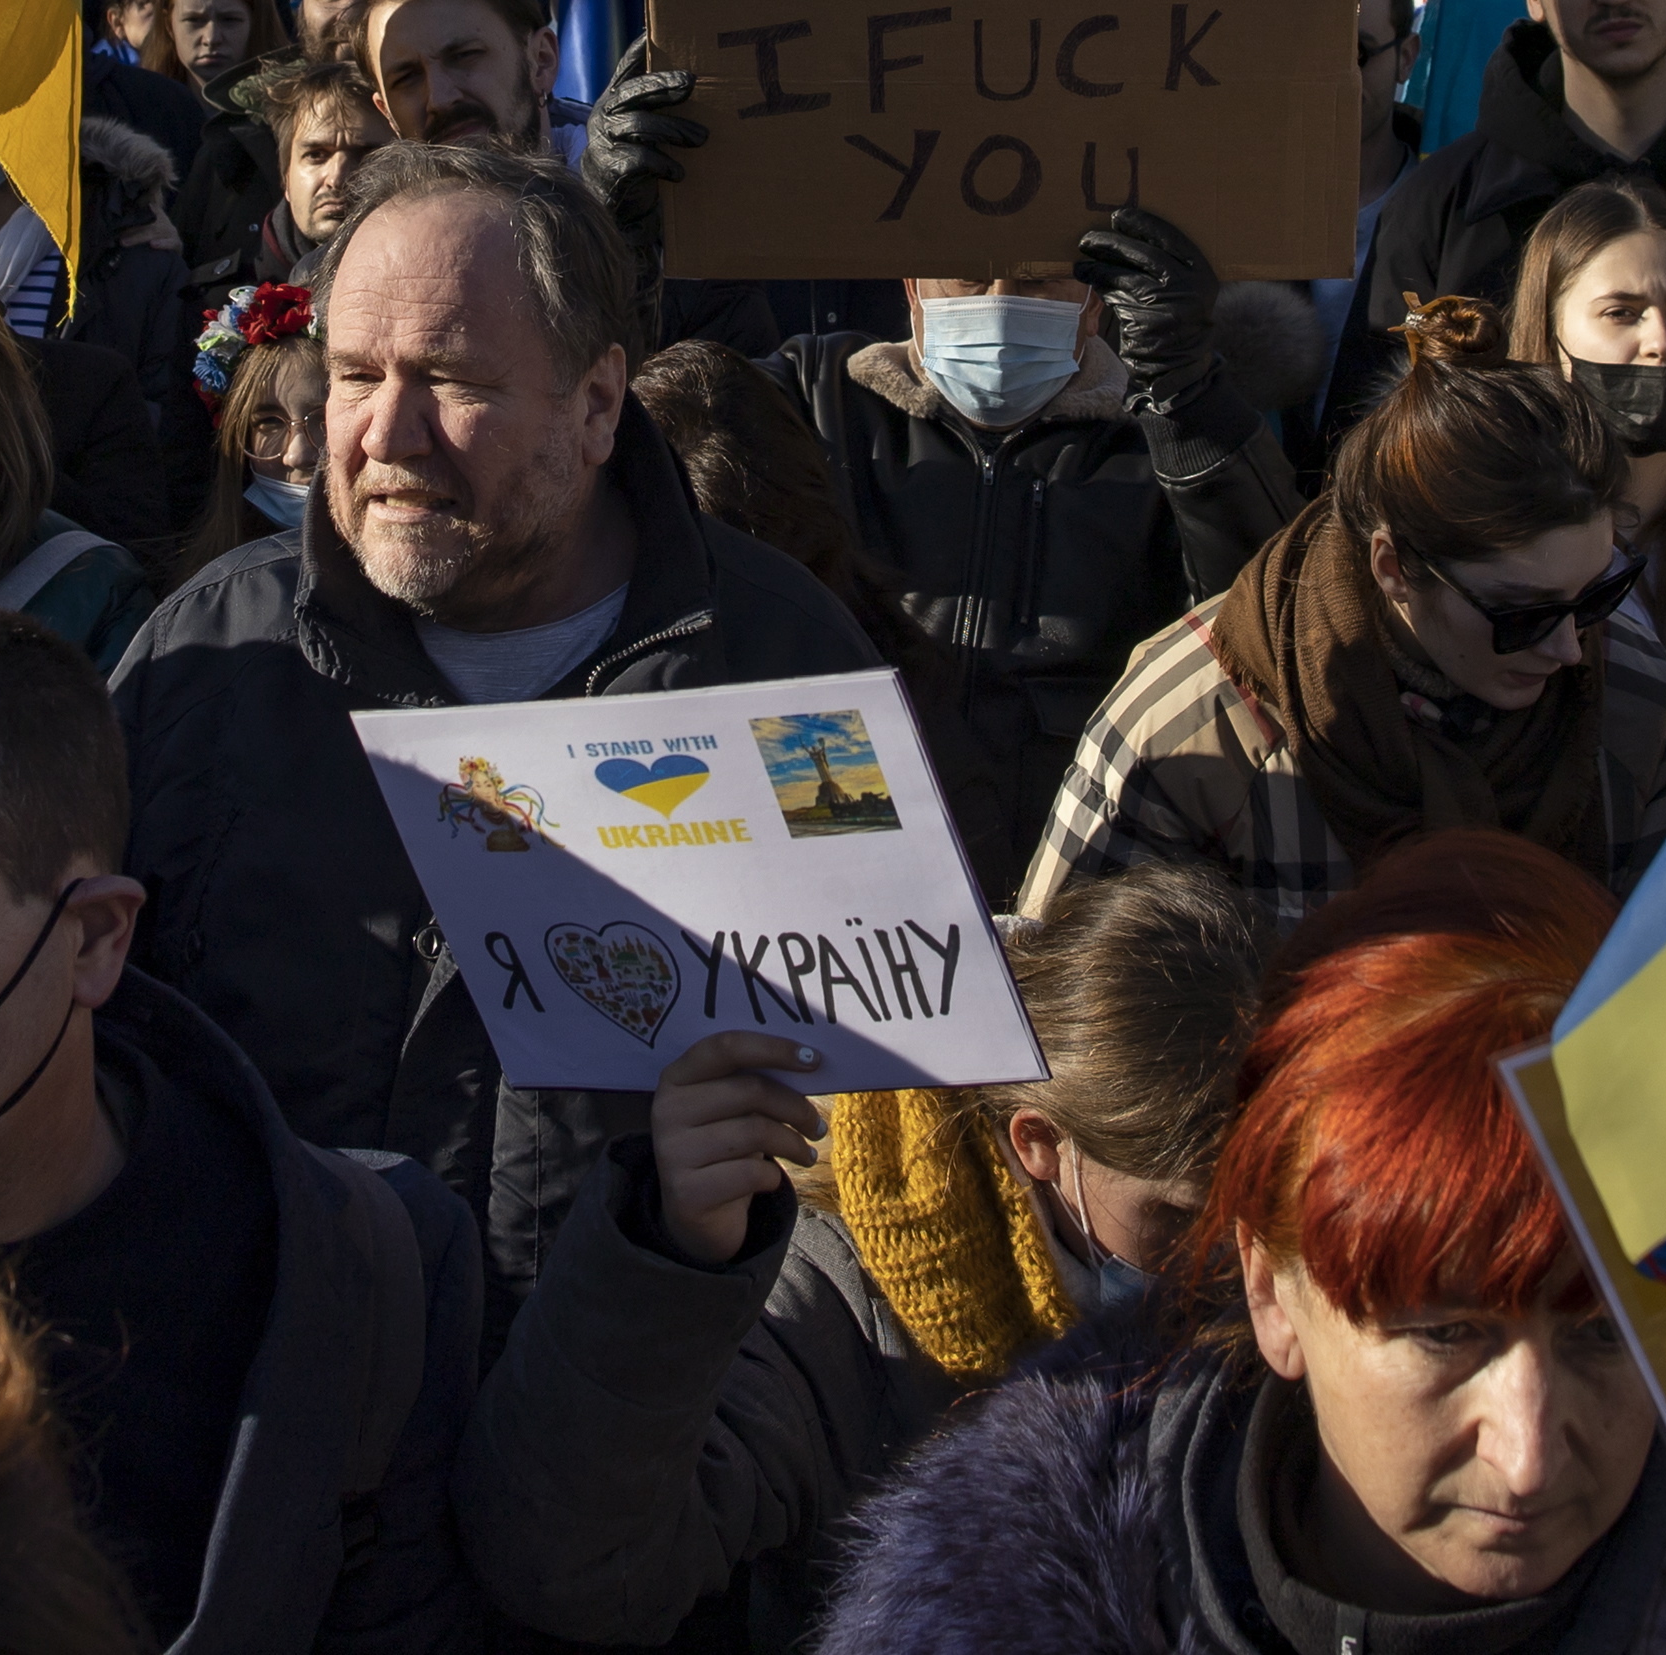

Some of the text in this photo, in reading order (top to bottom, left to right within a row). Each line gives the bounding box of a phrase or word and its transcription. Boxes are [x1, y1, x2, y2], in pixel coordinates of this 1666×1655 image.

[717, 3, 1224, 120] I FUCK
[844, 128, 1140, 223] YOU
[566, 734, 719, 760] I STAND WITH
[596, 818, 754, 850] UKRAINE
[484, 916, 961, 1026] Я УКРАЇНУ
